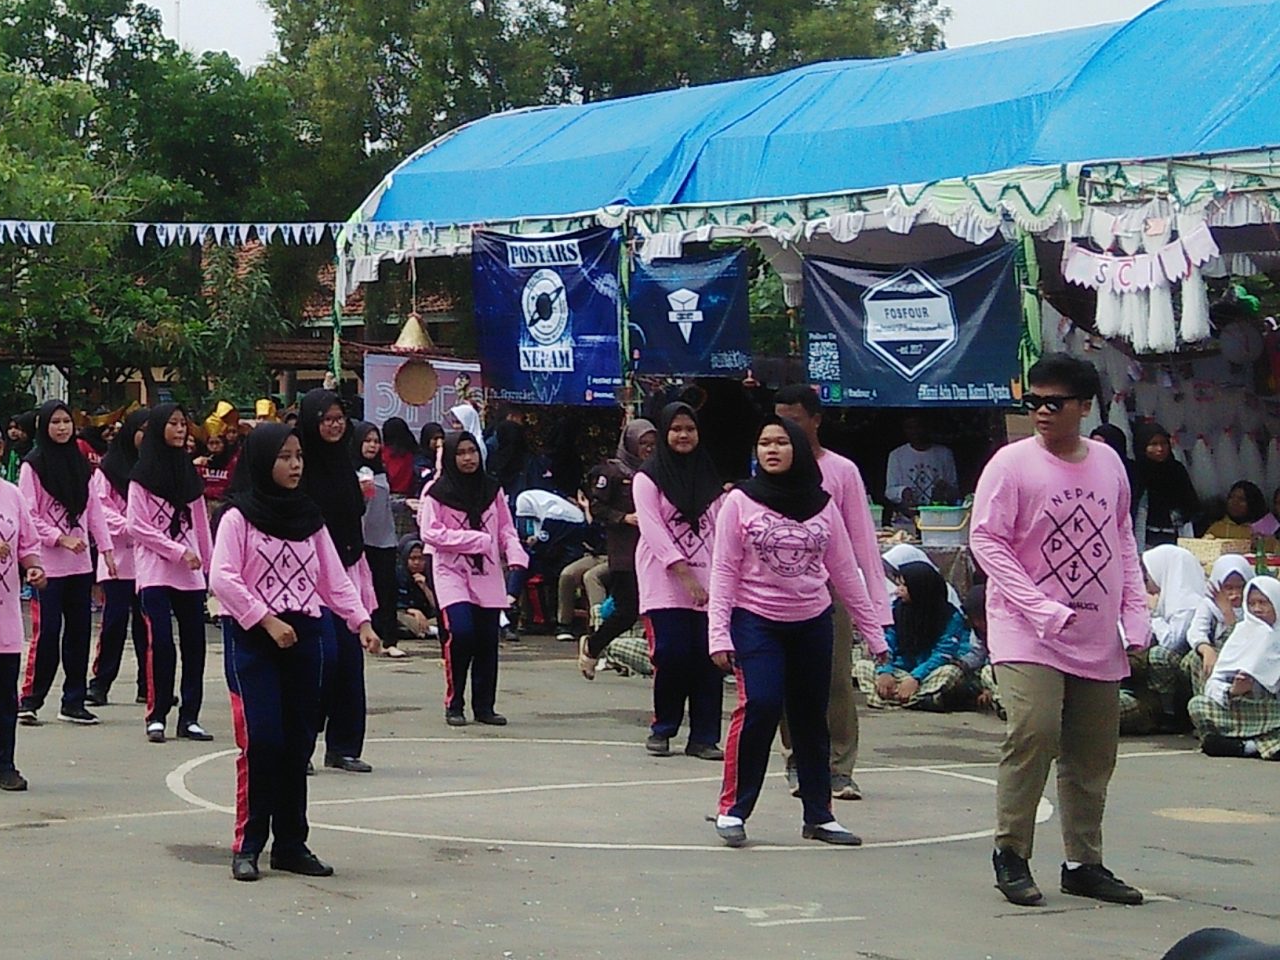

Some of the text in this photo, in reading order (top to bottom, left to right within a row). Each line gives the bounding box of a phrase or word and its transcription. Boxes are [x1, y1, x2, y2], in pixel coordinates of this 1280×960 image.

[510, 241, 579, 264] POSTARS
[884, 306, 930, 320] FOSFOUR
[1050, 488, 1108, 511] NEPAM
